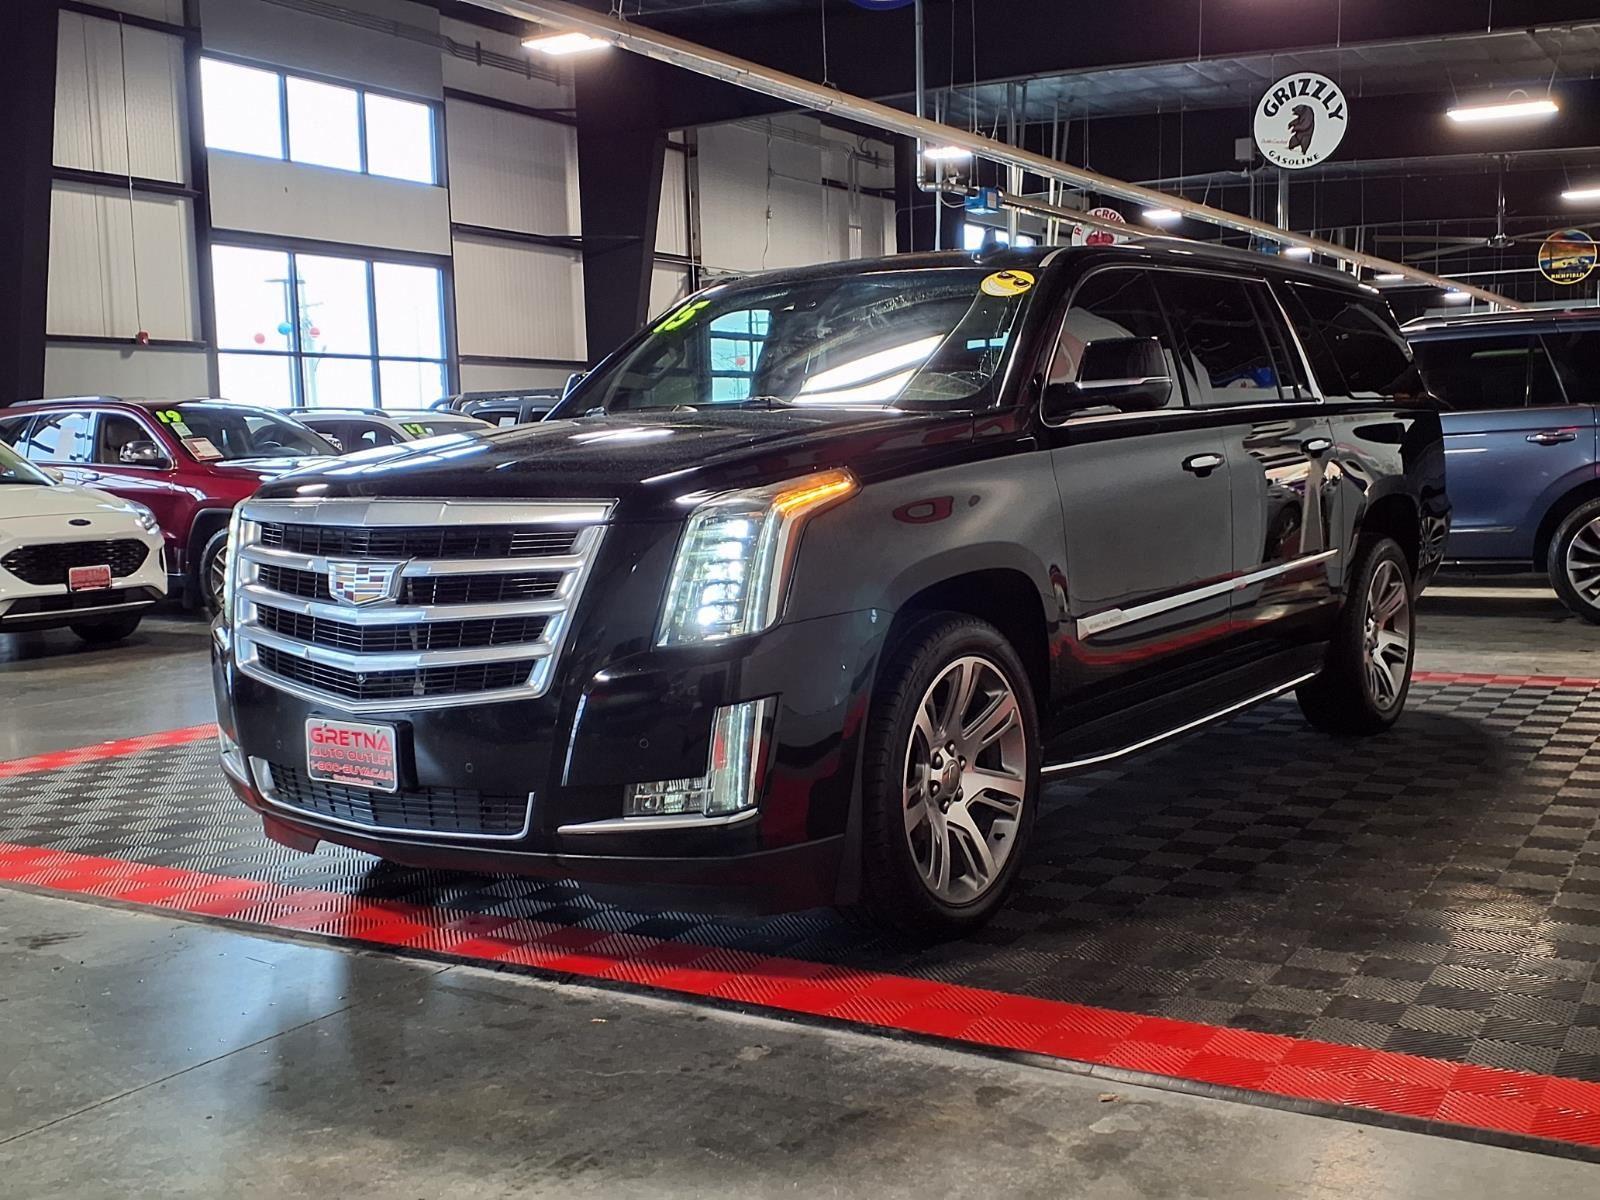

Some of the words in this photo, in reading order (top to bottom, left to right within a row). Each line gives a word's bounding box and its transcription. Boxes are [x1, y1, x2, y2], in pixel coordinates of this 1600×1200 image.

[1263, 78, 1344, 120] GRIZZLY
[1268, 150, 1320, 165] GASOLINE
[1094, 209, 1122, 223] CRO
[652, 299, 711, 333] 15
[155, 409, 182, 424] 19
[403, 423, 424, 434] 17
[310, 727, 392, 753] GRETNA
[310, 747, 345, 760] AUTO
[347, 750, 393, 767] OUTLET
